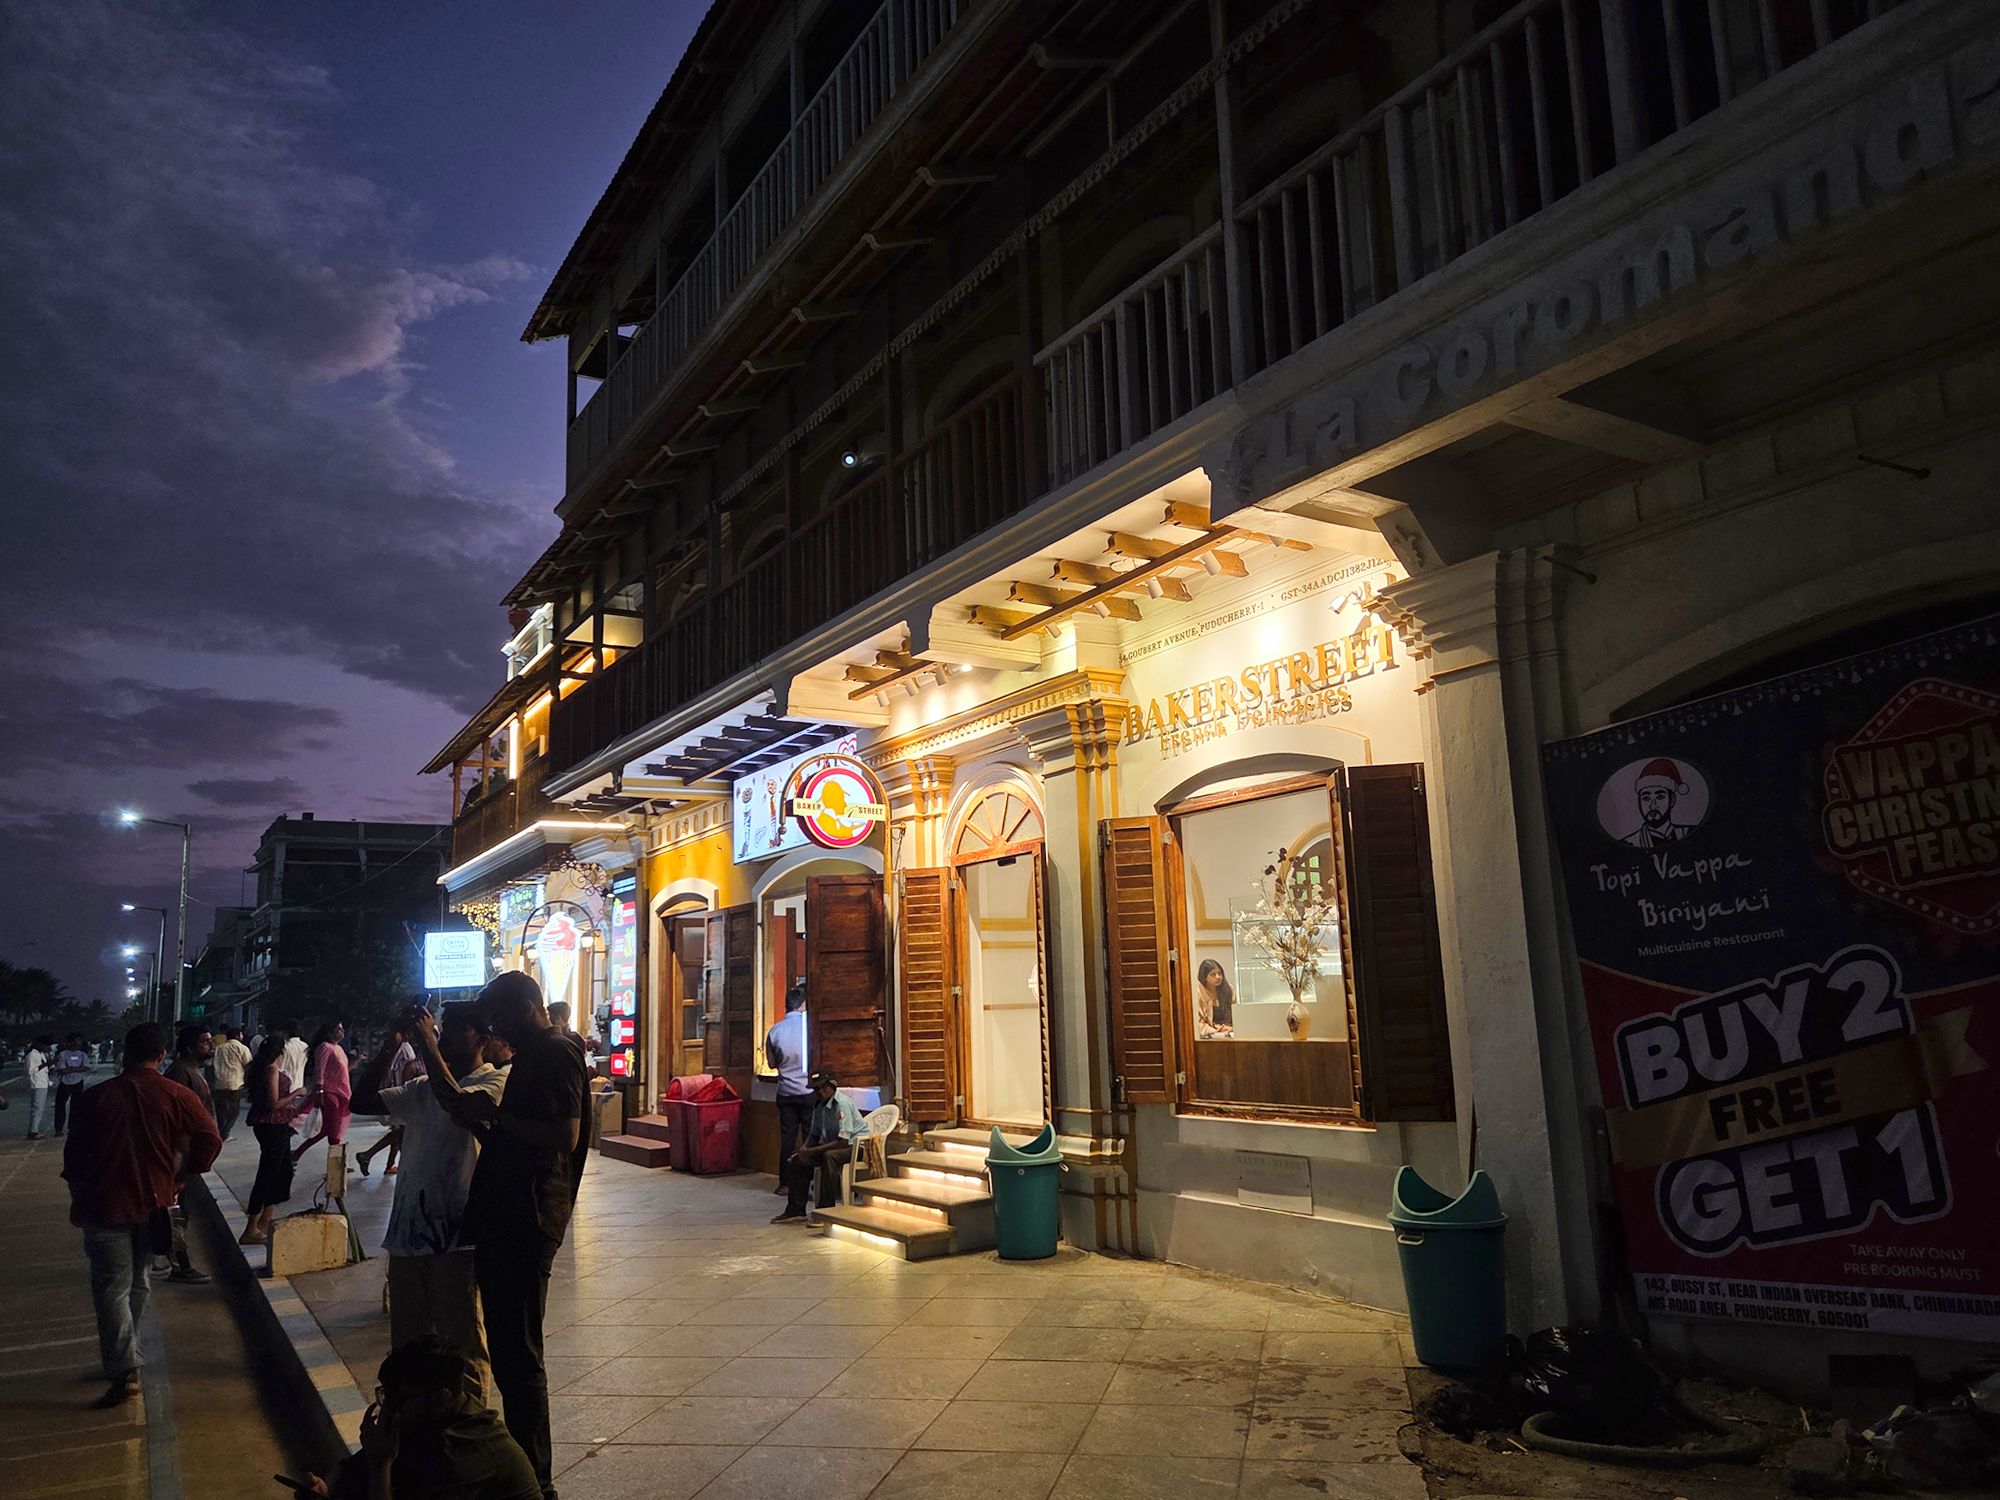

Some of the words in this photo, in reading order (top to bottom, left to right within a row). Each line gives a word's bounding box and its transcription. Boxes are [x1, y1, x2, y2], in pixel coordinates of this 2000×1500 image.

[1265, 394, 1360, 480] La
[796, 802, 822, 810] BAKER
[858, 806, 883, 816] STREET
[1893, 820, 2000, 880] FEAS
[1650, 851, 1753, 885] Vappa
[1637, 938, 1712, 958] Multicuisine
[1713, 927, 1786, 947] Restaurant
[1626, 978, 1811, 1104] BUY
[1840, 959, 1903, 1042] 2
[1709, 1068, 1842, 1142] FREE
[1668, 1124, 1861, 1243] GET
[1873, 1109, 1935, 1209] 1
[1849, 1244, 1883, 1257] TAKE
[1886, 1246, 1926, 1259] AWAY
[1928, 1247, 1968, 1260] ONLY
[1843, 1263, 1868, 1275] PRE
[1870, 1263, 1937, 1279] BOOKING
[1940, 1267, 1982, 1281] MUST
[1648, 1296, 1664, 1311] MG
[1668, 1298, 1697, 1313] ROAD
[1734, 1303, 1815, 1326] PUDUCHERRY,
[1818, 1310, 1868, 1328] 605001
[1670, 1279, 1705, 1295] BUSSY
[1727, 1284, 1758, 1299] NEAR
[1760, 1286, 1801, 1302] INDIAN
[1804, 1289, 1867, 1306] OVERSEAS
[1870, 1293, 1911, 1312] BANK,
